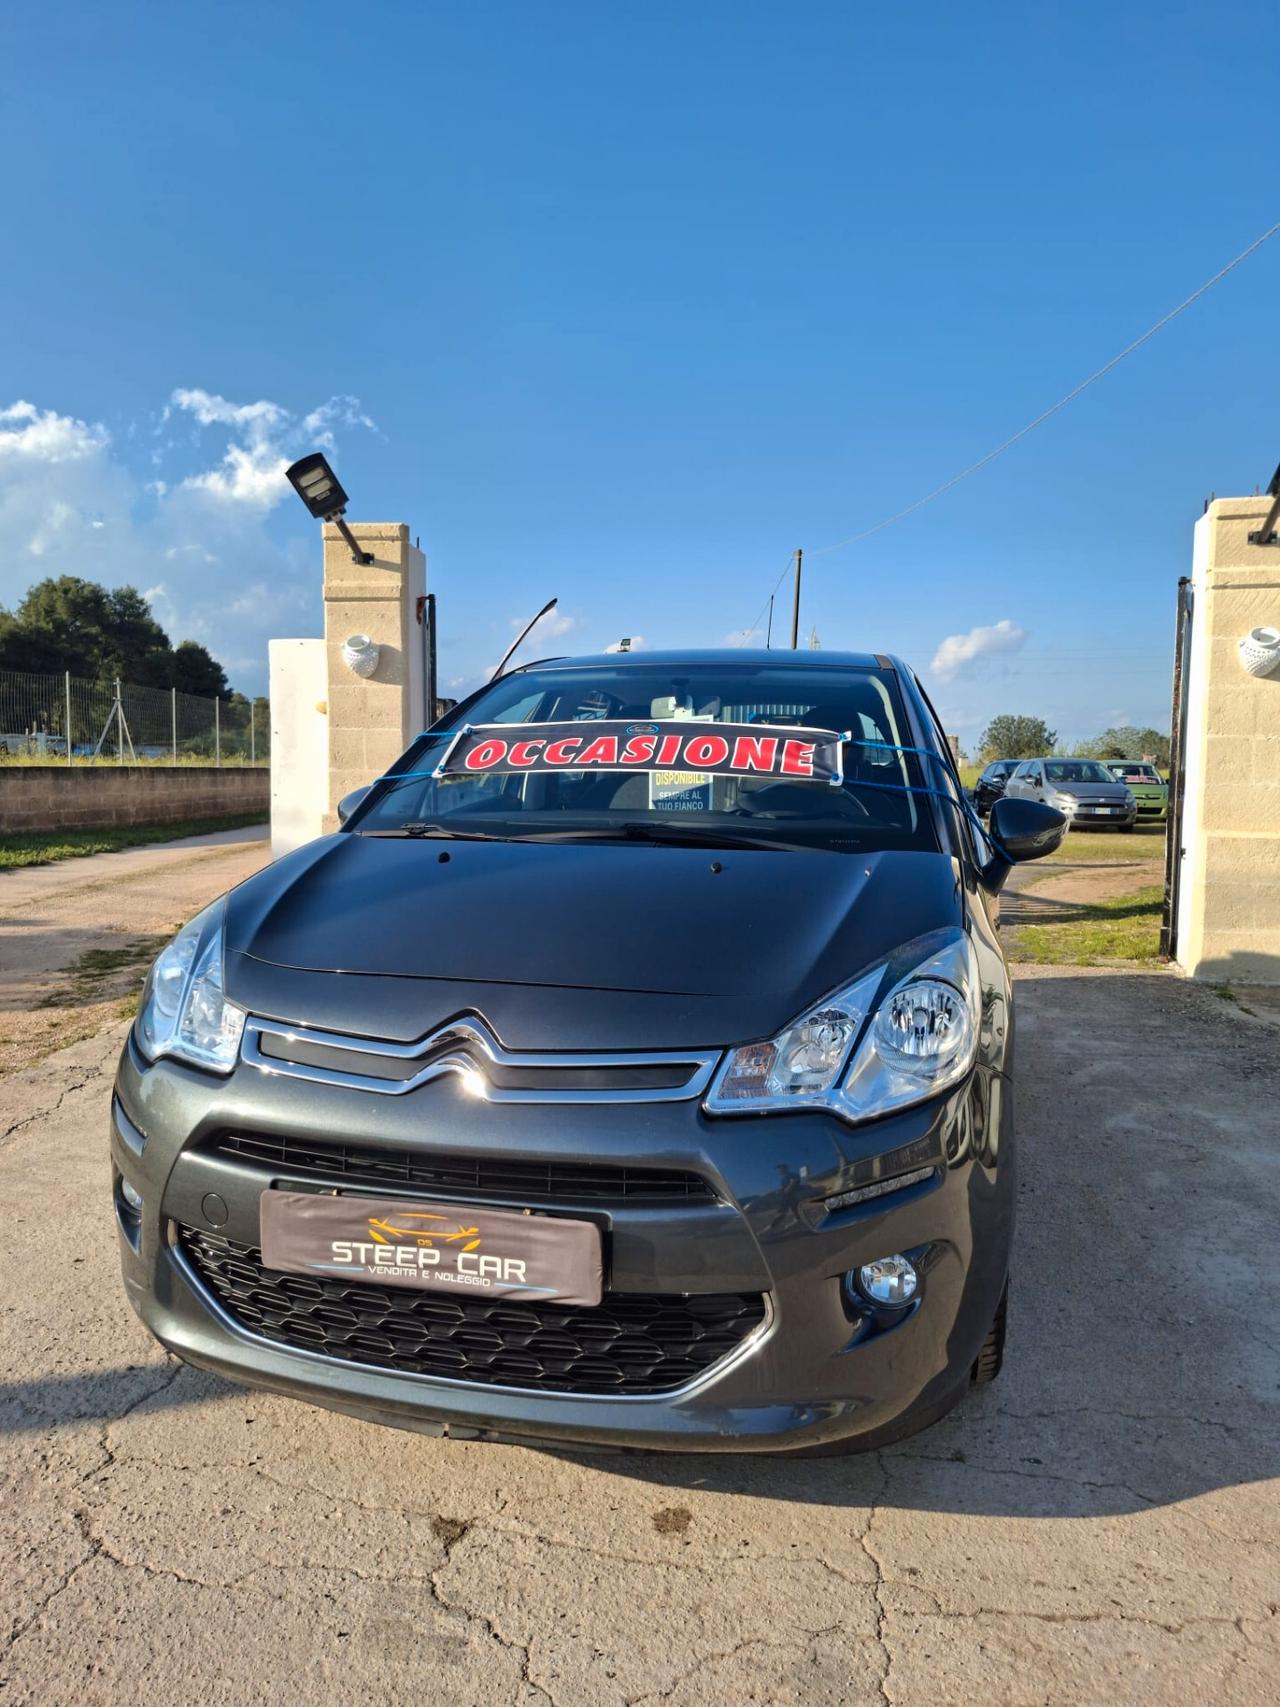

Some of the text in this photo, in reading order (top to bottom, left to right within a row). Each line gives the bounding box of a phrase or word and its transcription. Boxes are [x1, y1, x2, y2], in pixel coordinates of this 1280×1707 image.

[465, 735, 814, 776] OCCASIONE
[655, 772, 705, 786] DISPONIBILE
[659, 790, 702, 800] SEMPRE AL
[657, 801, 703, 811] TUO FIANCO
[332, 1241, 527, 1283] STEEP CAR
[367, 1265, 491, 1287] VENDITA E NOLEGGIO
